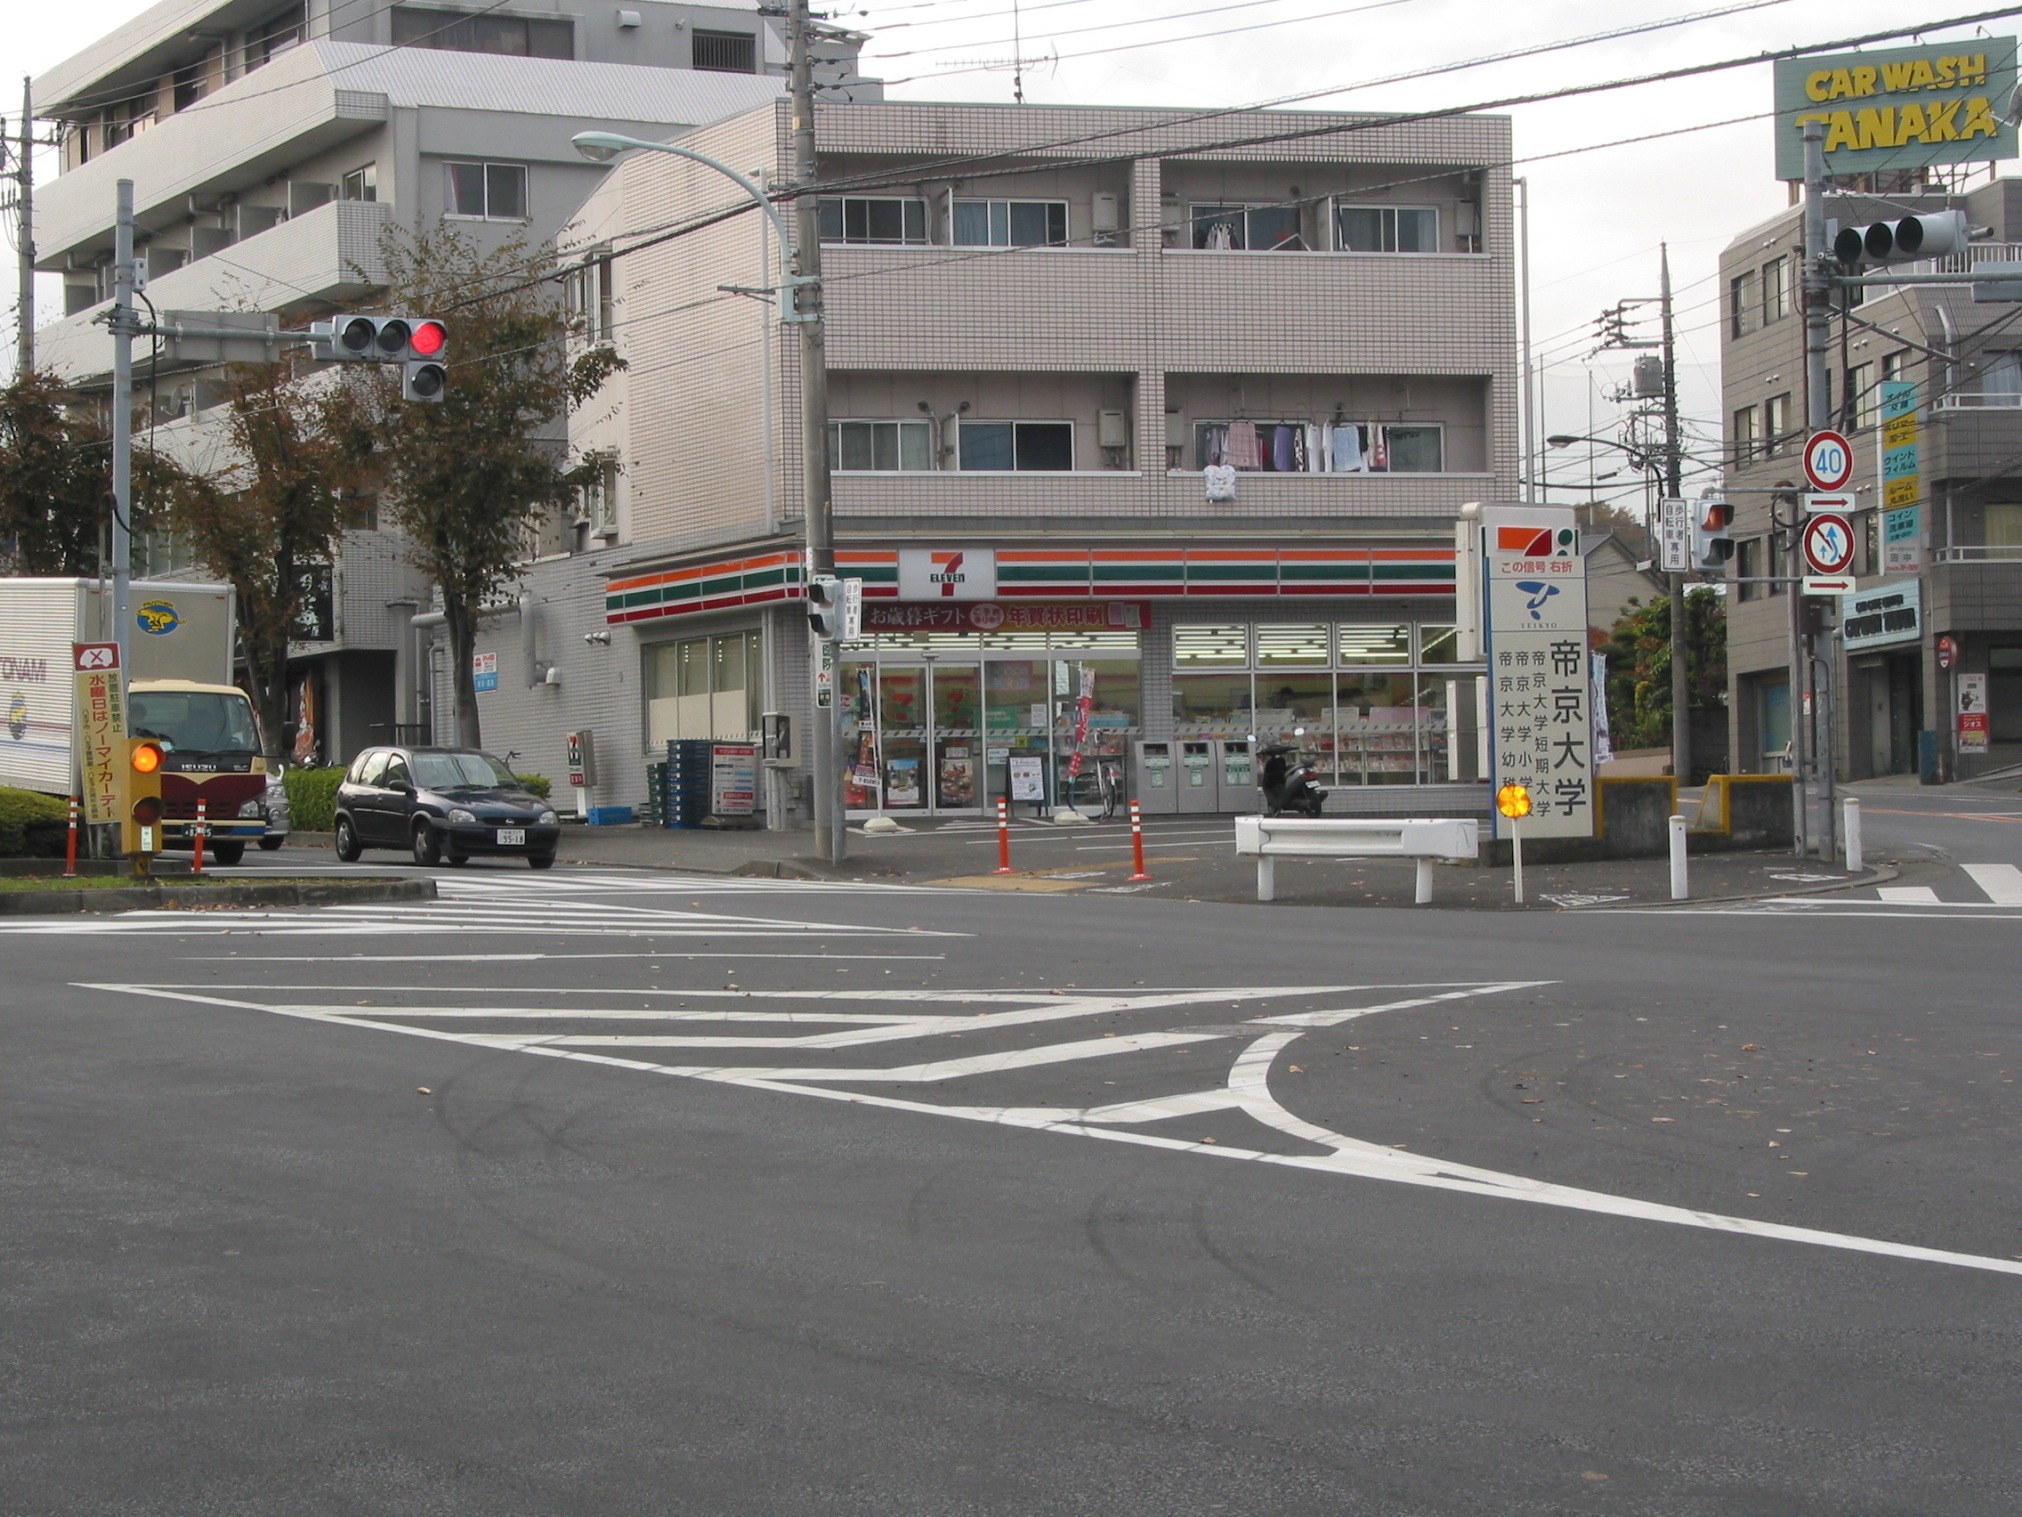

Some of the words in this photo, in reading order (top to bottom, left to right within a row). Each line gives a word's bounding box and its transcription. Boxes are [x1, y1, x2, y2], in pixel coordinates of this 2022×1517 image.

[1805, 65, 1877, 102] CAR
[1880, 53, 1986, 92] WASH
[1795, 96, 1998, 152] TANAKA
[1816, 448, 1842, 474] 40
[1665, 505, 1674, 540] 自転車
[1675, 505, 1684, 541] 歩行者
[1888, 510, 1913, 523] コイン
[1501, 561, 1546, 574] この信号
[1550, 561, 1573, 573] 右折
[1670, 542, 1680, 565] 専用
[931, 552, 963, 597] 7
[870, 607, 965, 626] お歳暮ギフト
[1008, 605, 1105, 627] 年賀状印刷
[107, 673, 122, 733] 放置駐車禁止
[1499, 651, 1517, 818] 帝京大学幼稚
[1532, 650, 1551, 818] 帝京大学短期大学
[1550, 639, 1587, 817] 帝京大学
